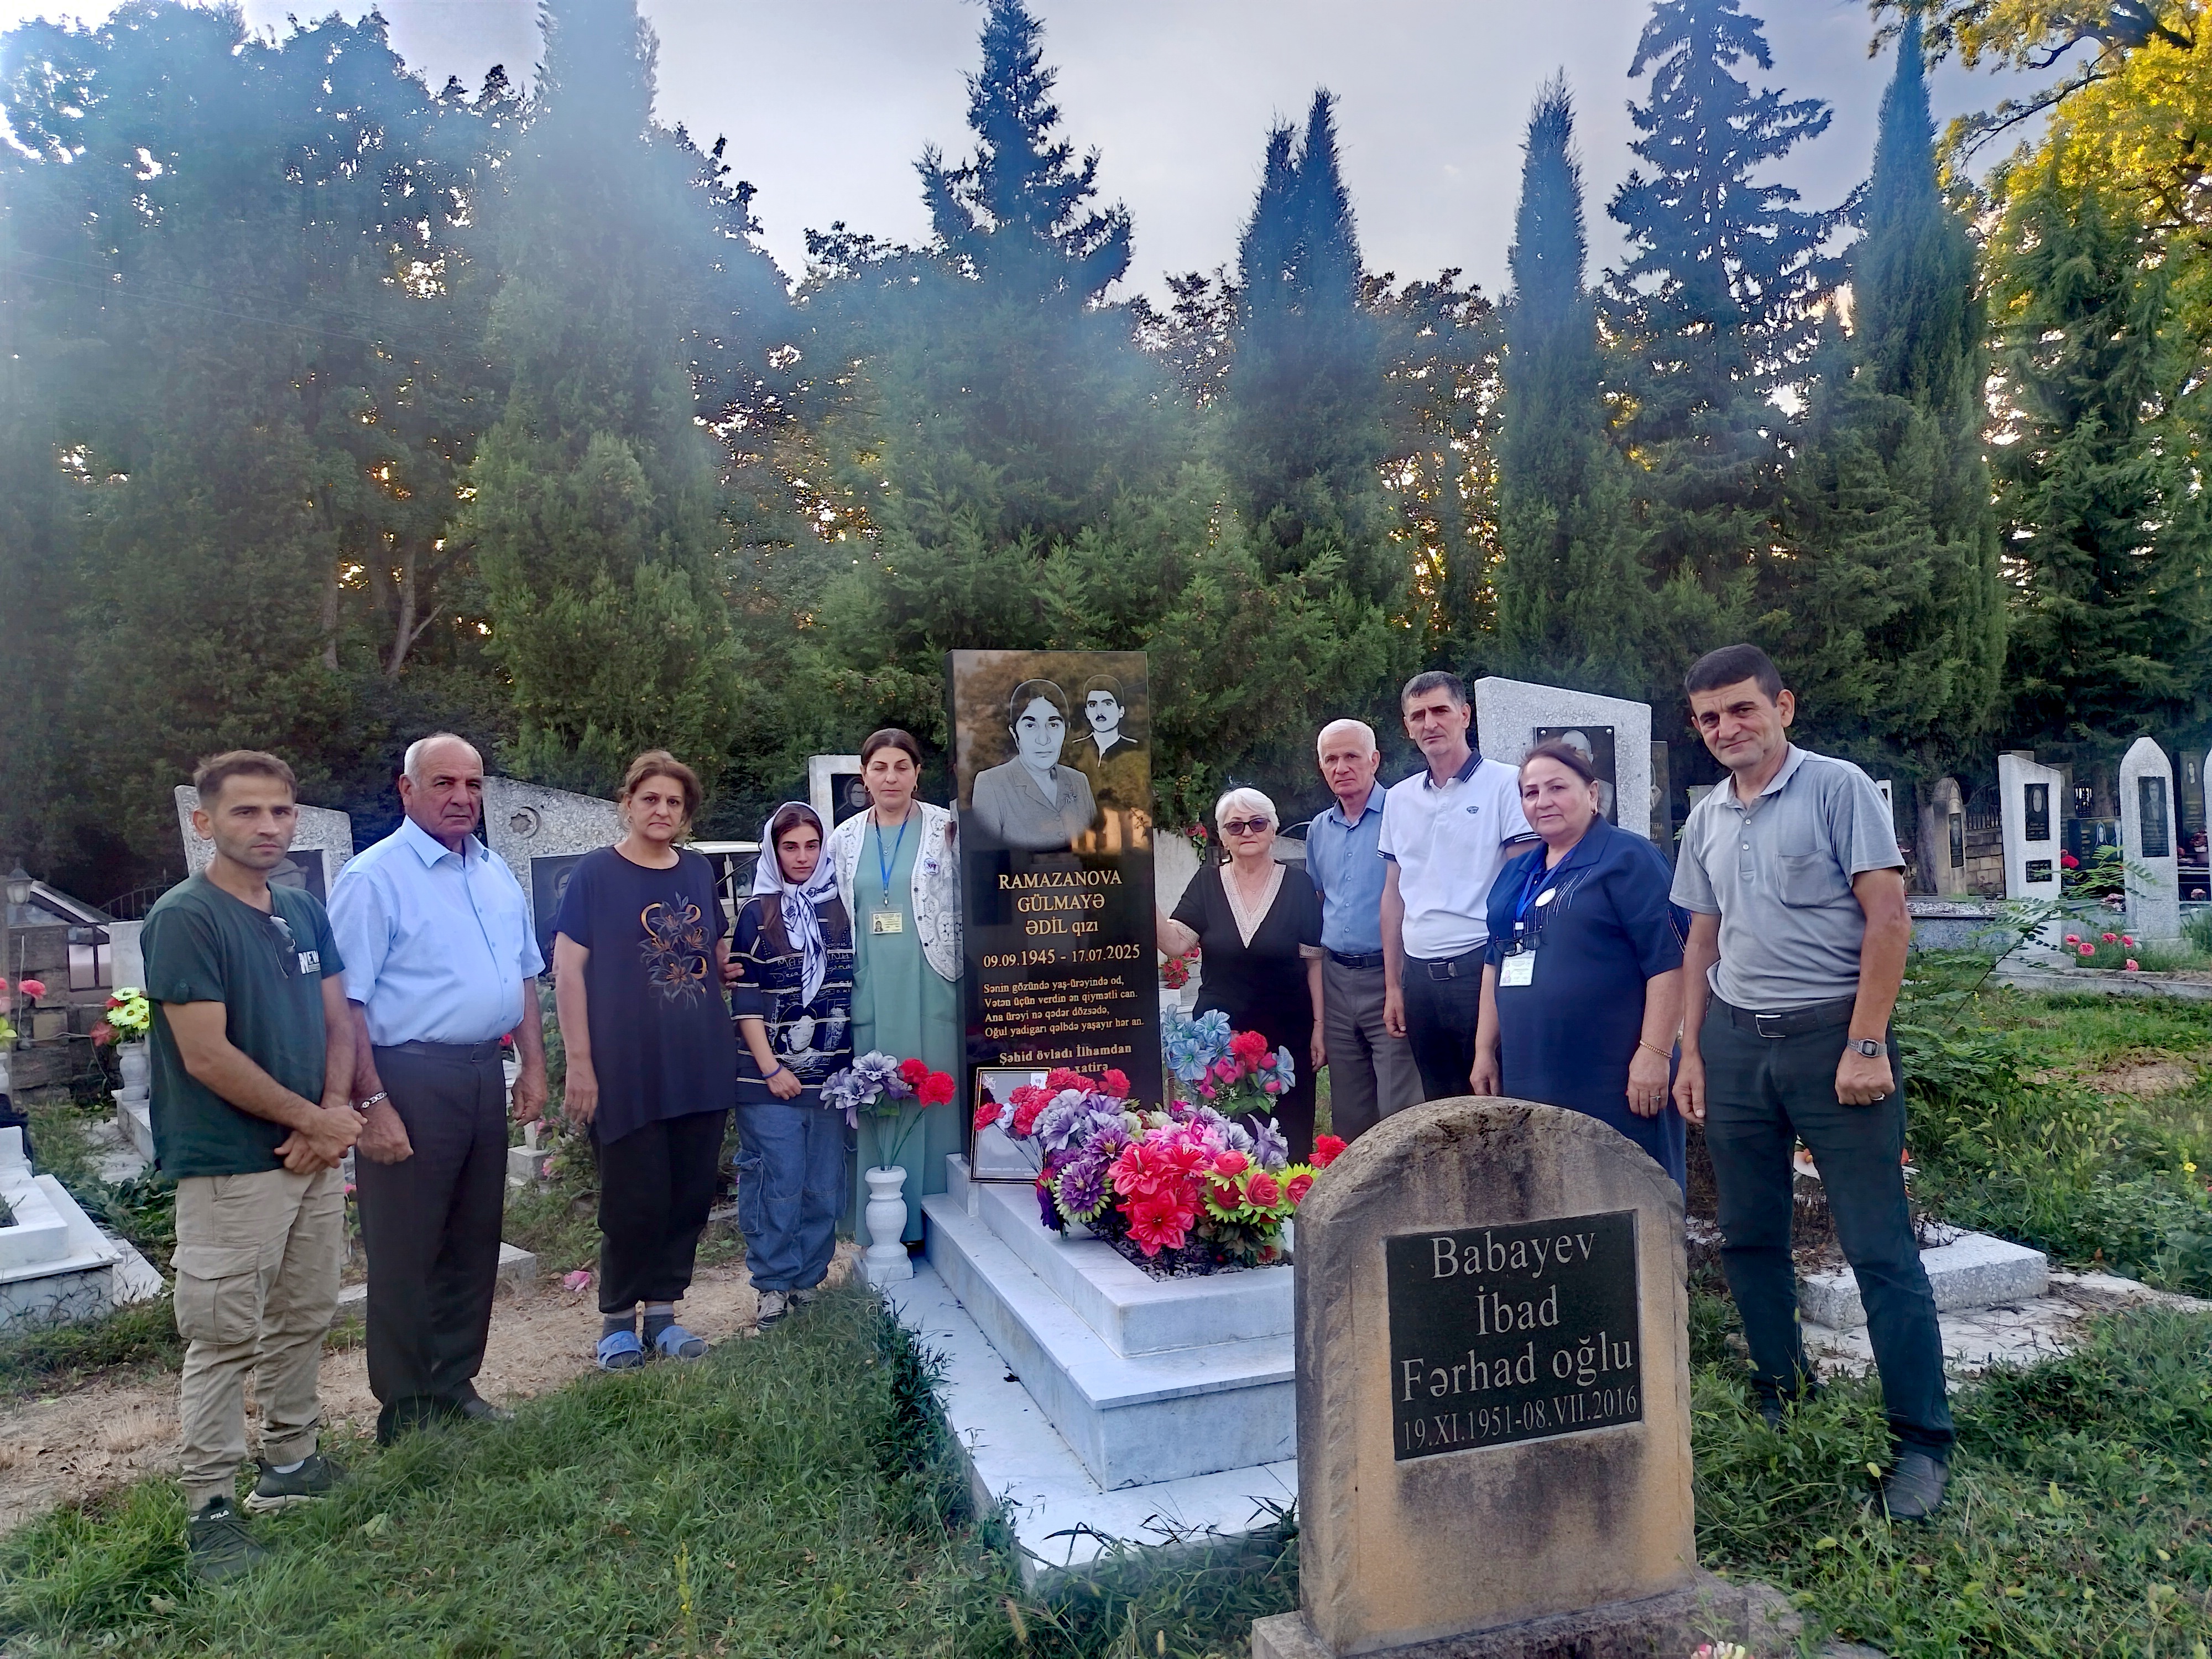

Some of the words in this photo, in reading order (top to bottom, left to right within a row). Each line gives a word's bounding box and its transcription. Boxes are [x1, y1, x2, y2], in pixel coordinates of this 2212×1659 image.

[998, 870, 1123, 889] RAMAZANOVA
[1018, 893, 1105, 912] GÜLMAYƏ
[1025, 916, 1068, 935] ƏDİL
[1072, 921, 1099, 937] qızı
[983, 949, 1055, 968] 09.09.1945
[1072, 944, 1140, 963] 17.07.2025
[984, 983, 1010, 993] Sənin
[1012, 980, 1050, 994] gözündə
[1052, 976, 1108, 991] yaş-ürəyində
[1110, 975, 1124, 986] od,
[984, 998, 1011, 1008] Vətən
[1014, 996, 1035, 1008] üçün
[1038, 993, 1066, 1004] verdin
[1082, 989, 1118, 1004] qiymətli
[1120, 990, 1138, 999] can.
[985, 1013, 1004, 1022] Ana
[1006, 1010, 1029, 1022] ürəyi
[1045, 1008, 1070, 1021] qədər
[1072, 1004, 1110, 1016] dözsədə,
[985, 1026, 1008, 1039] Oğul
[1010, 1024, 1047, 1037] yadigarı
[1049, 1021, 1079, 1035] qəlbdə
[1081, 1020, 1113, 1032] yaşayır
[1115, 1018, 1130, 1027] hər
[999, 1051, 1033, 1066] Şəhid
[1036, 1047, 1073, 1061] övladı
[1076, 1044, 1132, 1057] İlhamdan
[1074, 1062, 1109, 1073] xatirə
[1429, 1230, 1597, 1279] Babayev
[1474, 1285, 1560, 1336] İbad
[1400, 1341, 1538, 1402] Fərhad
[1552, 1331, 1633, 1386] oğlu
[1404, 1384, 1637, 1451] 19.XI.1951-08.VII.2016
